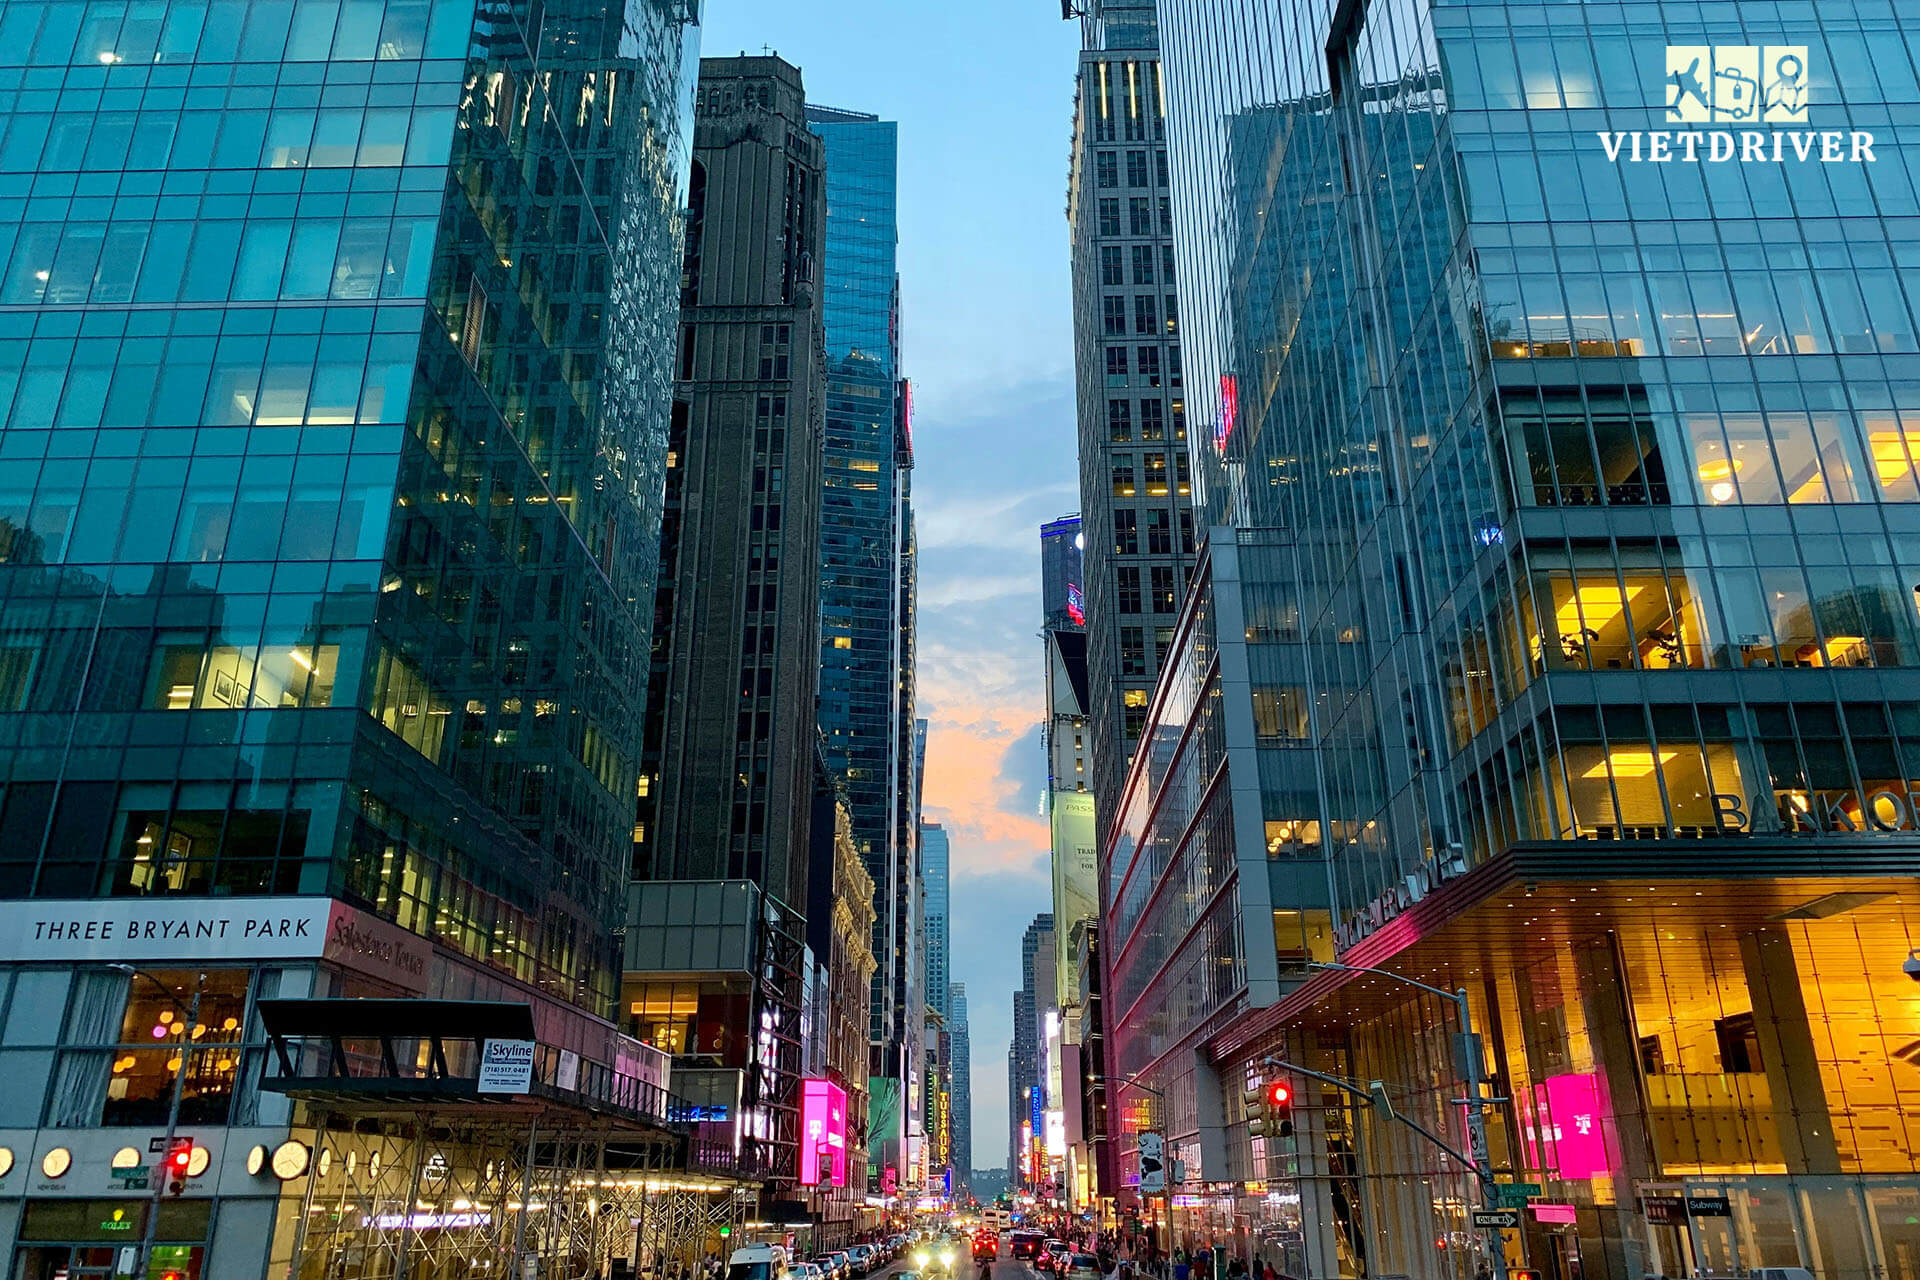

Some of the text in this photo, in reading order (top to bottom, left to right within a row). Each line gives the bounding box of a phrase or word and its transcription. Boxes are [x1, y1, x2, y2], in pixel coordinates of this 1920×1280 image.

[1712, 793, 1857, 837] BANK
[35, 918, 311, 940] THREE BRYANT PARK
[493, 1044, 532, 1060] Skyline
[939, 1092, 949, 1165] TUSSAUDS
[1690, 1201, 1723, 1210] Subway
